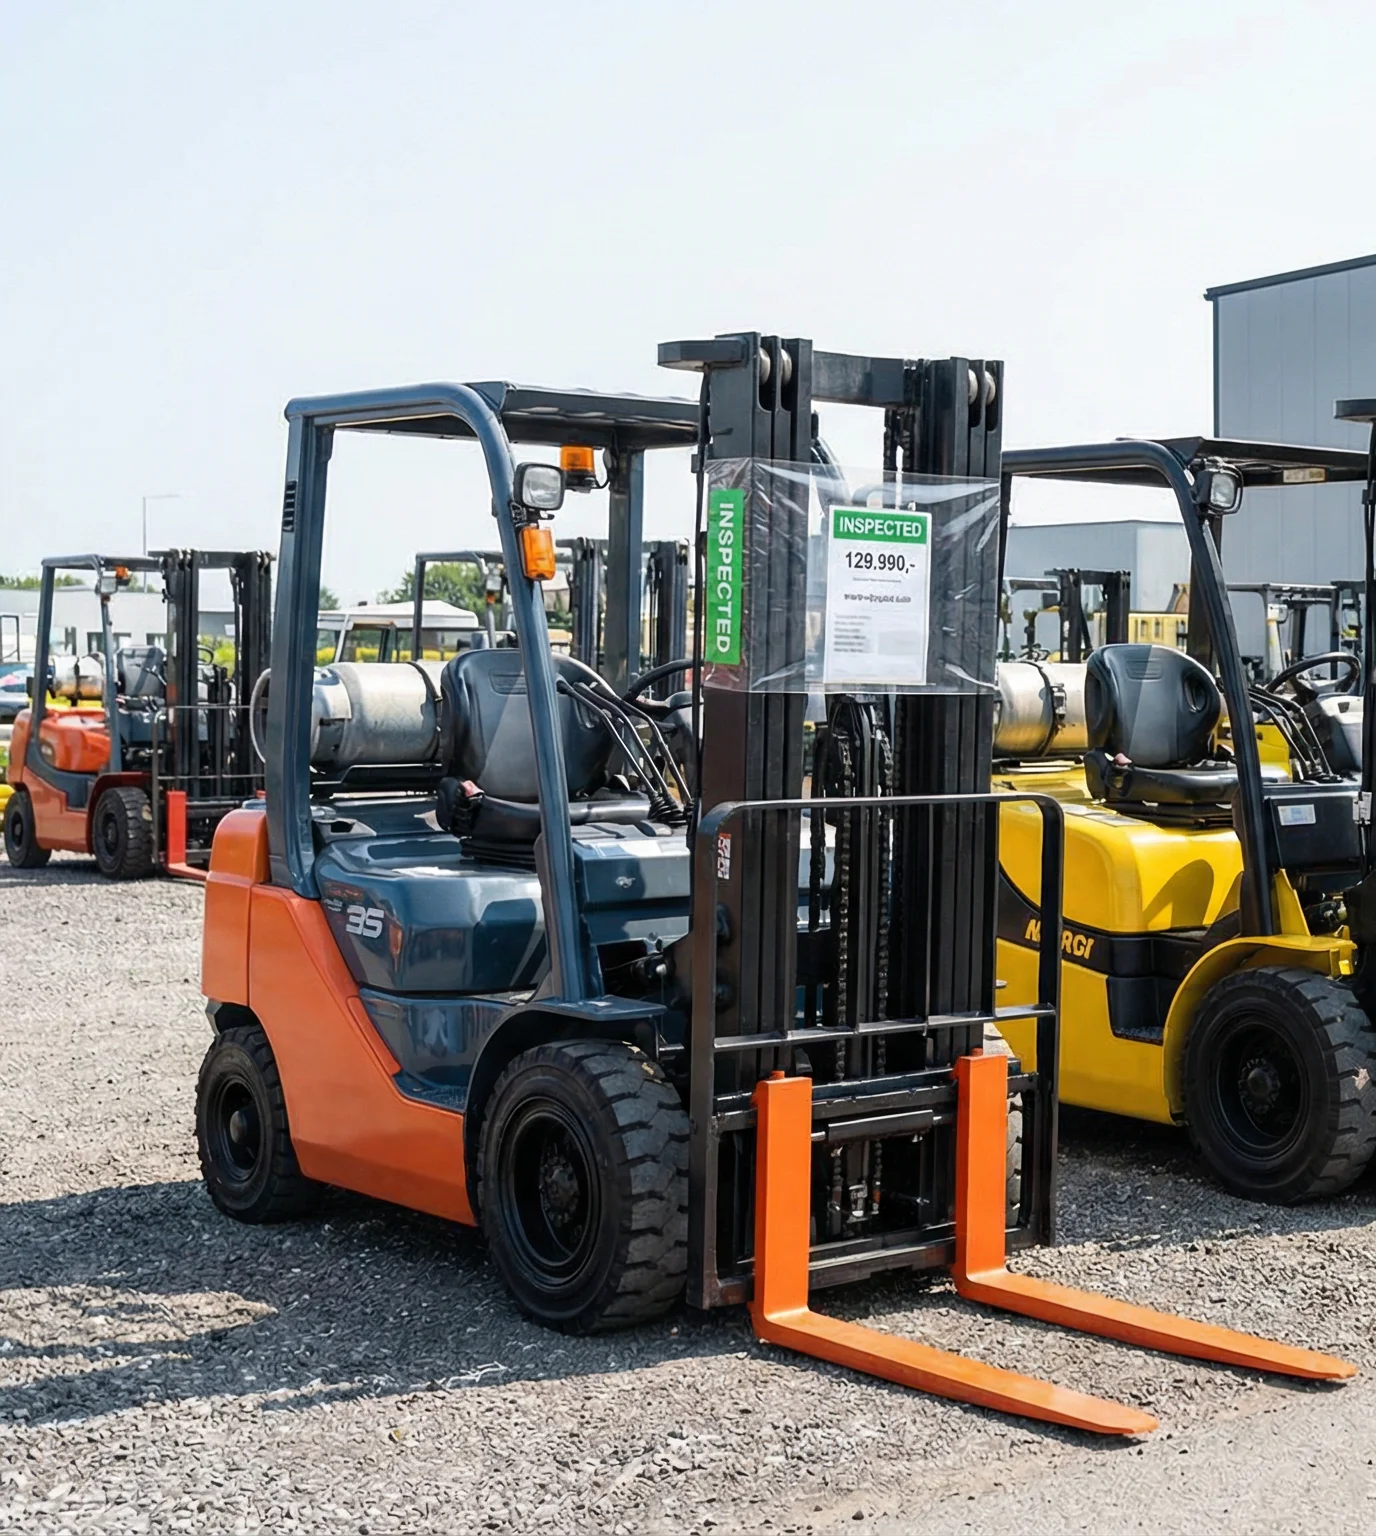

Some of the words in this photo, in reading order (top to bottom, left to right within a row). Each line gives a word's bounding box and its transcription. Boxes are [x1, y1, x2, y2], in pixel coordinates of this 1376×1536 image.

[839, 516, 922, 537] INSPECTED
[845, 551, 915, 574] 129.990,-
[716, 502, 734, 653] INSPECTED
[345, 904, 385, 938] 35
